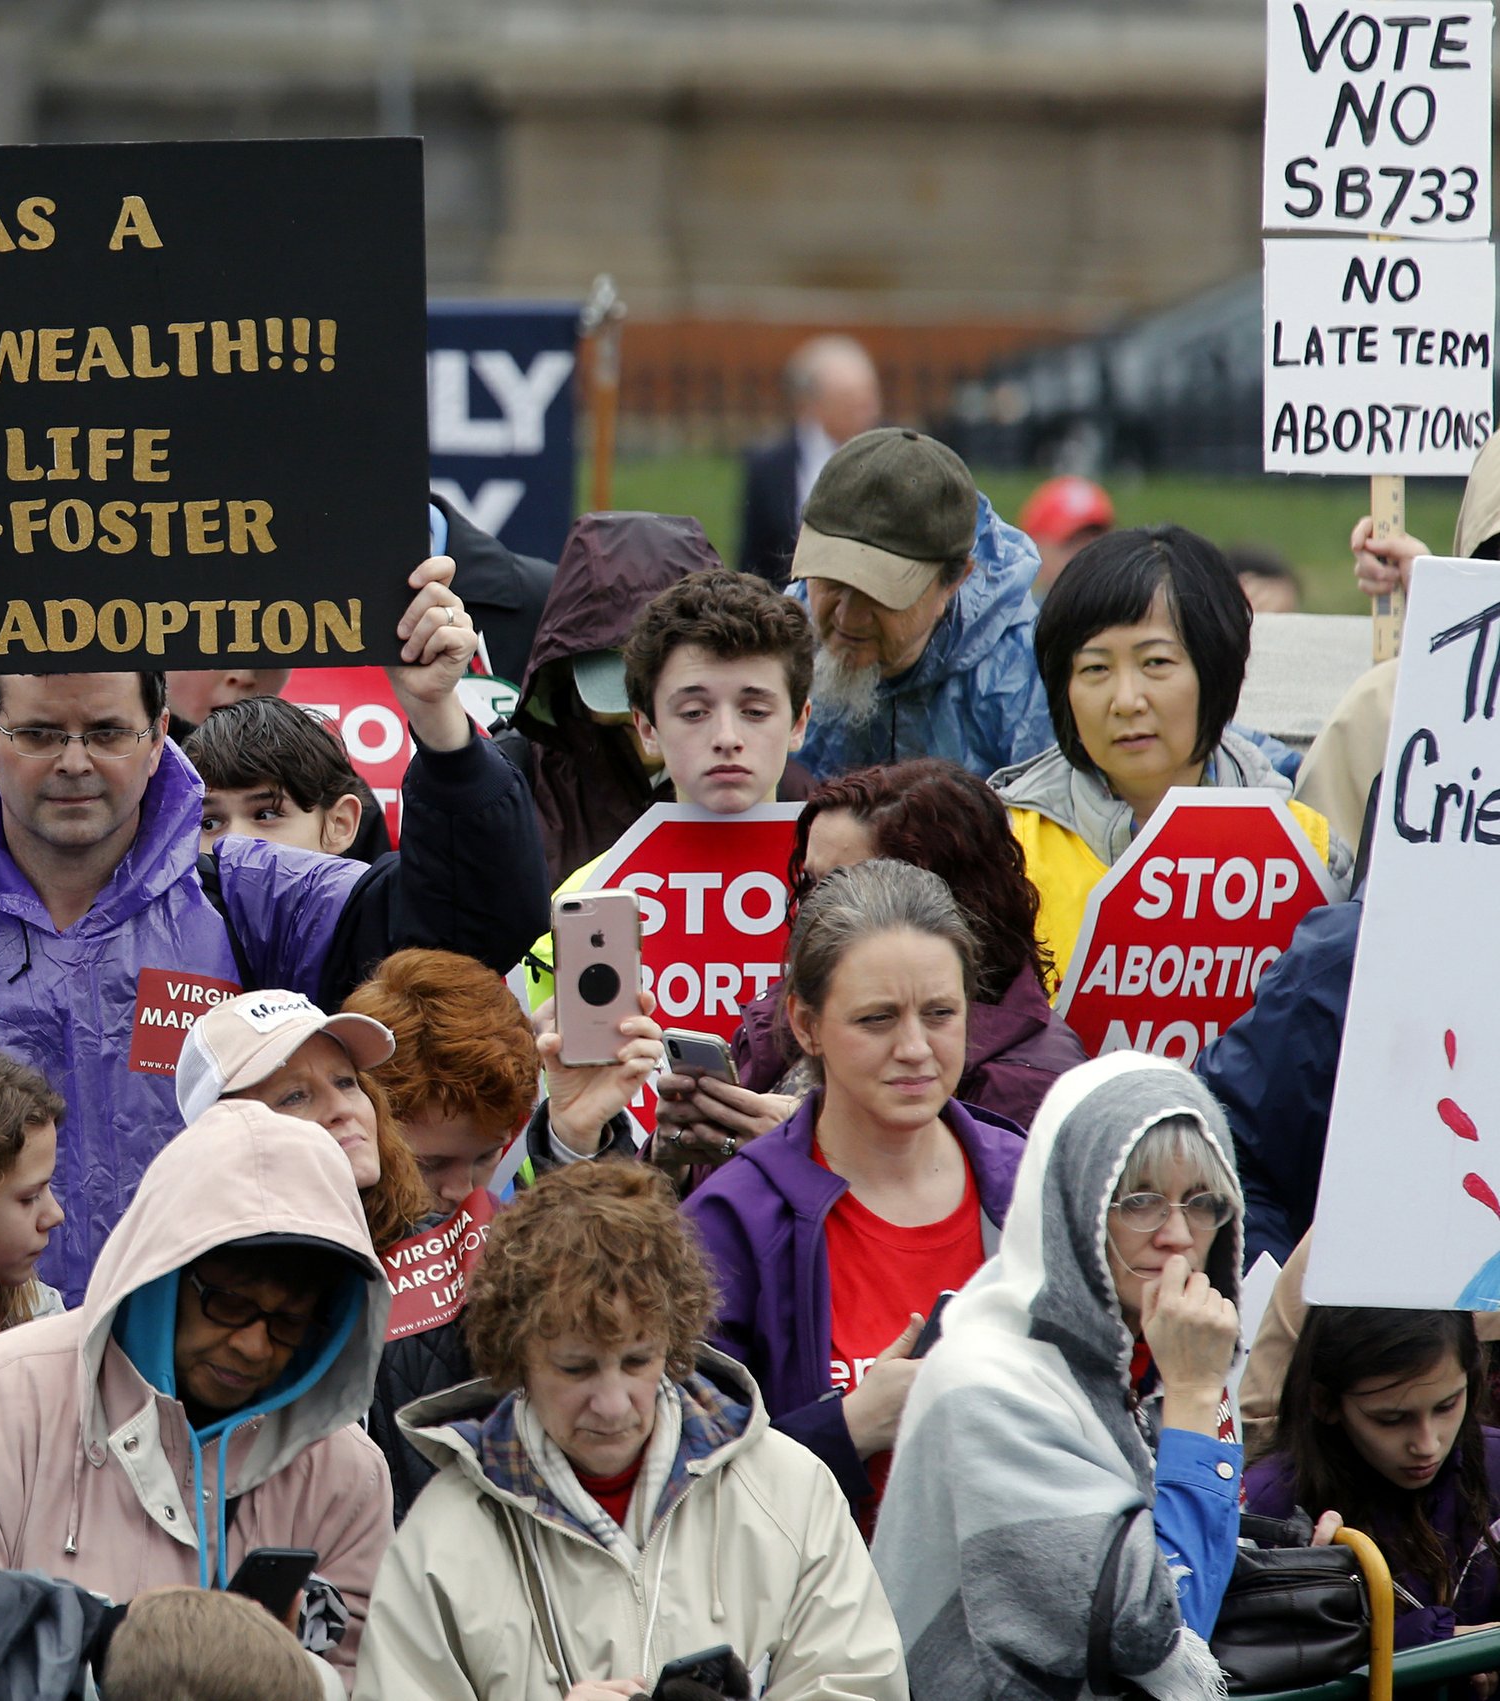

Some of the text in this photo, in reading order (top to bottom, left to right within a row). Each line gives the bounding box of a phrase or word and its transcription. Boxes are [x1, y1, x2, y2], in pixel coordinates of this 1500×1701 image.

[1294, 4, 1471, 73] VOTE
[1326, 81, 1436, 148] NO
[1284, 157, 1479, 228] SB733
[109, 195, 163, 251] A
[1342, 257, 1421, 303] NO
[1273, 322, 1490, 367] LATE TERM
[6, 427, 171, 483] LIFE
[1272, 401, 1491, 454] ABORTIONS
[9, 498, 277, 557] FOSTER
[618, 871, 787, 937] STO
[1133, 857, 1299, 920] STOP
[1080, 945, 1282, 998] ABORTIO
[140, 1007, 202, 1030] MAR
[387, 1210, 473, 1269] VIRGINIA
